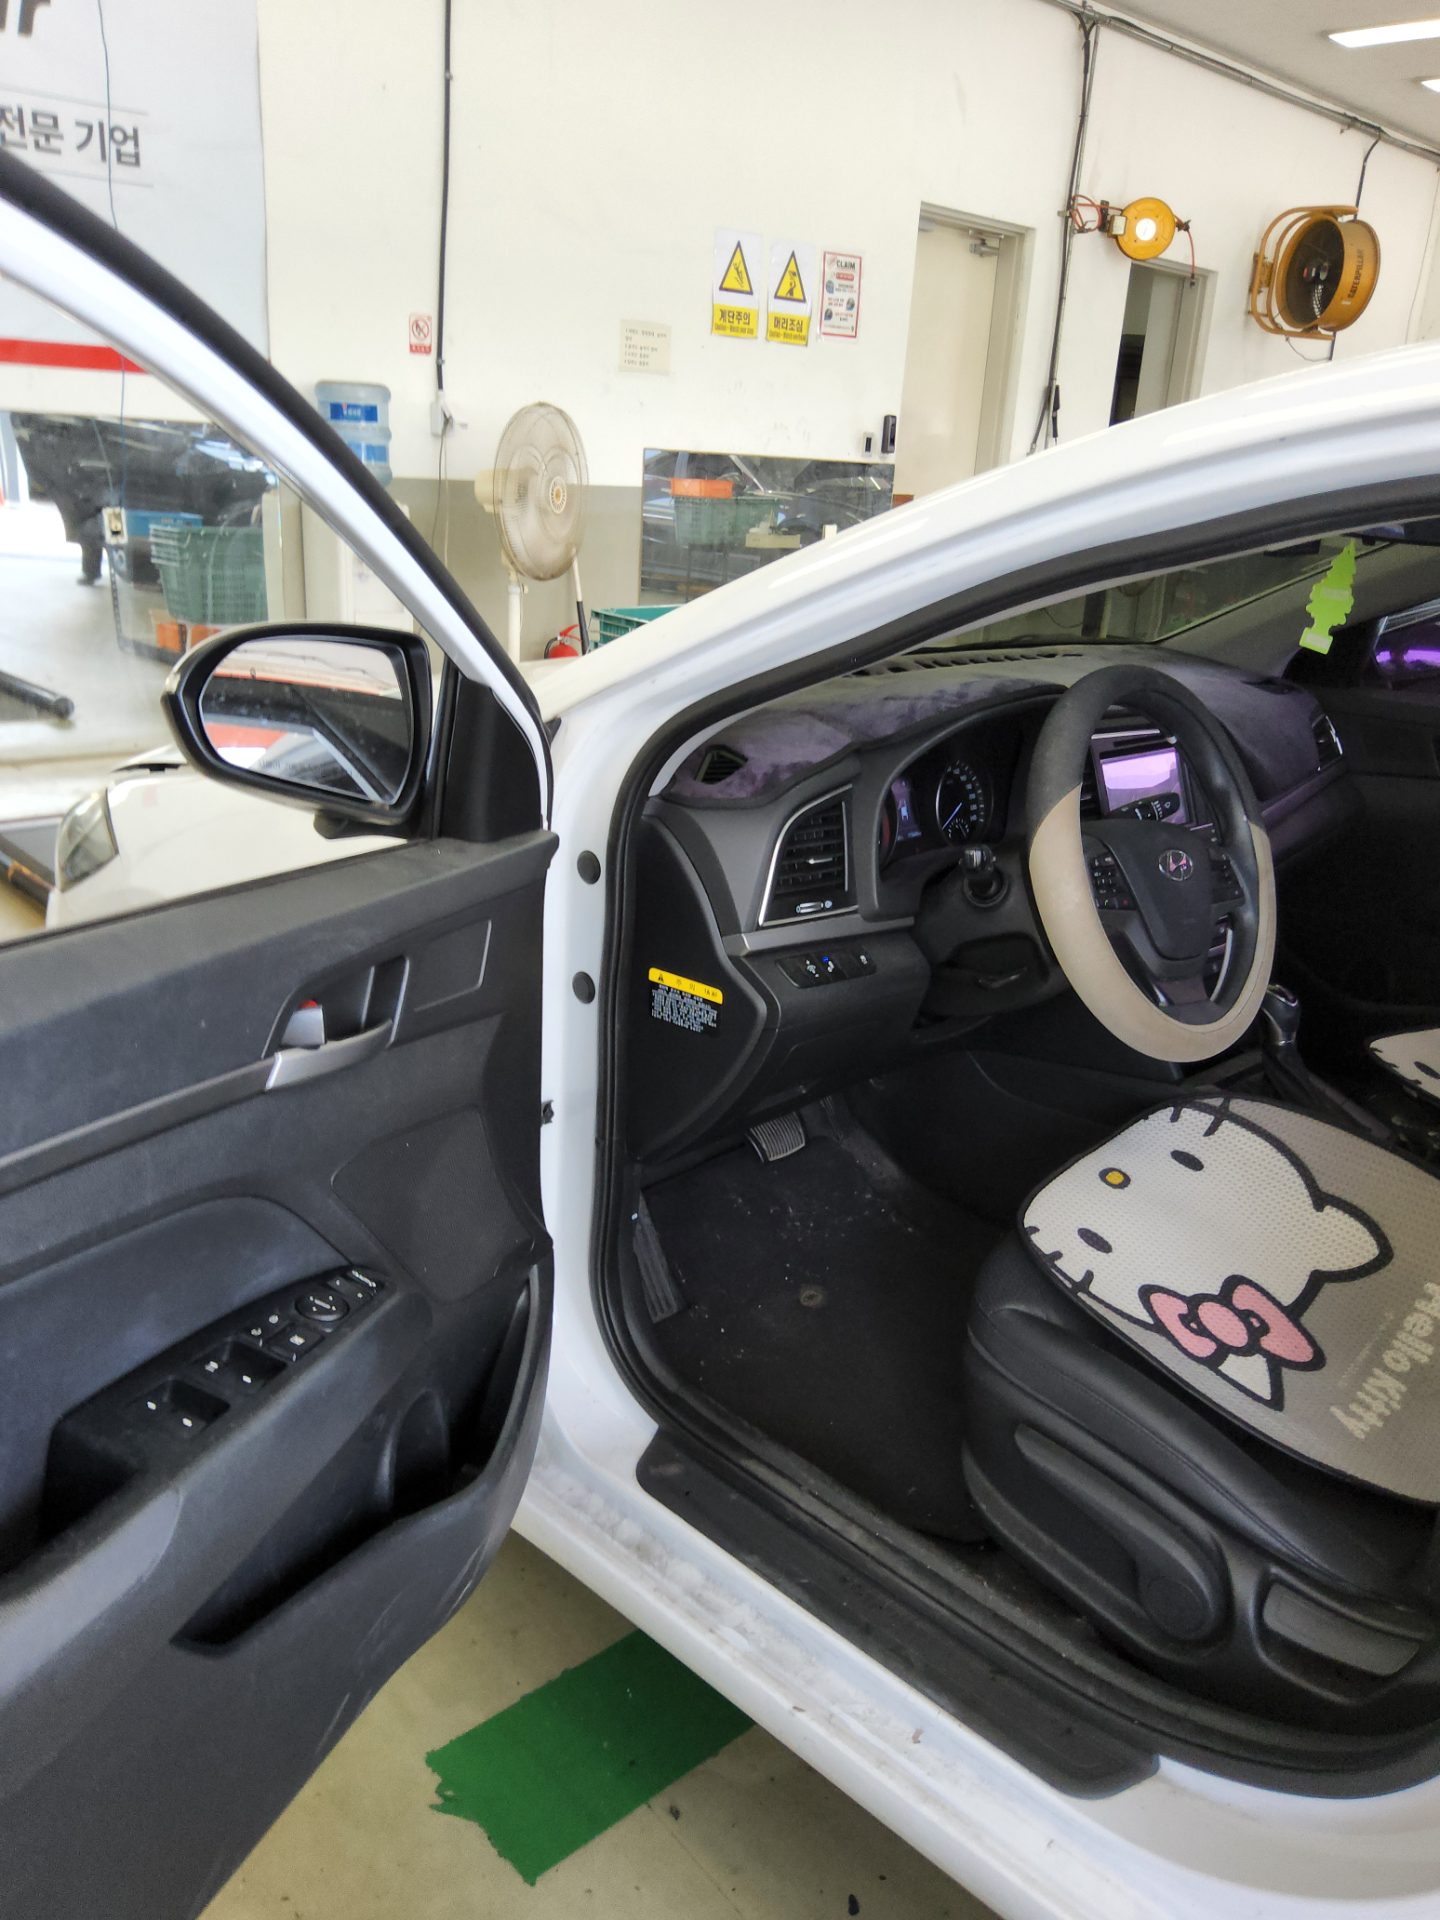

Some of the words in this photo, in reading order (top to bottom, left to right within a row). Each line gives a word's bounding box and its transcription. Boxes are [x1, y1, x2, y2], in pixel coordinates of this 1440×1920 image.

[0, 104, 64, 155] 전문
[75, 119, 141, 167] 기업
[719, 309, 751, 326] 계단주의
[773, 316, 804, 333] 머리조심
[1329, 1367, 1408, 1439] Kitty
